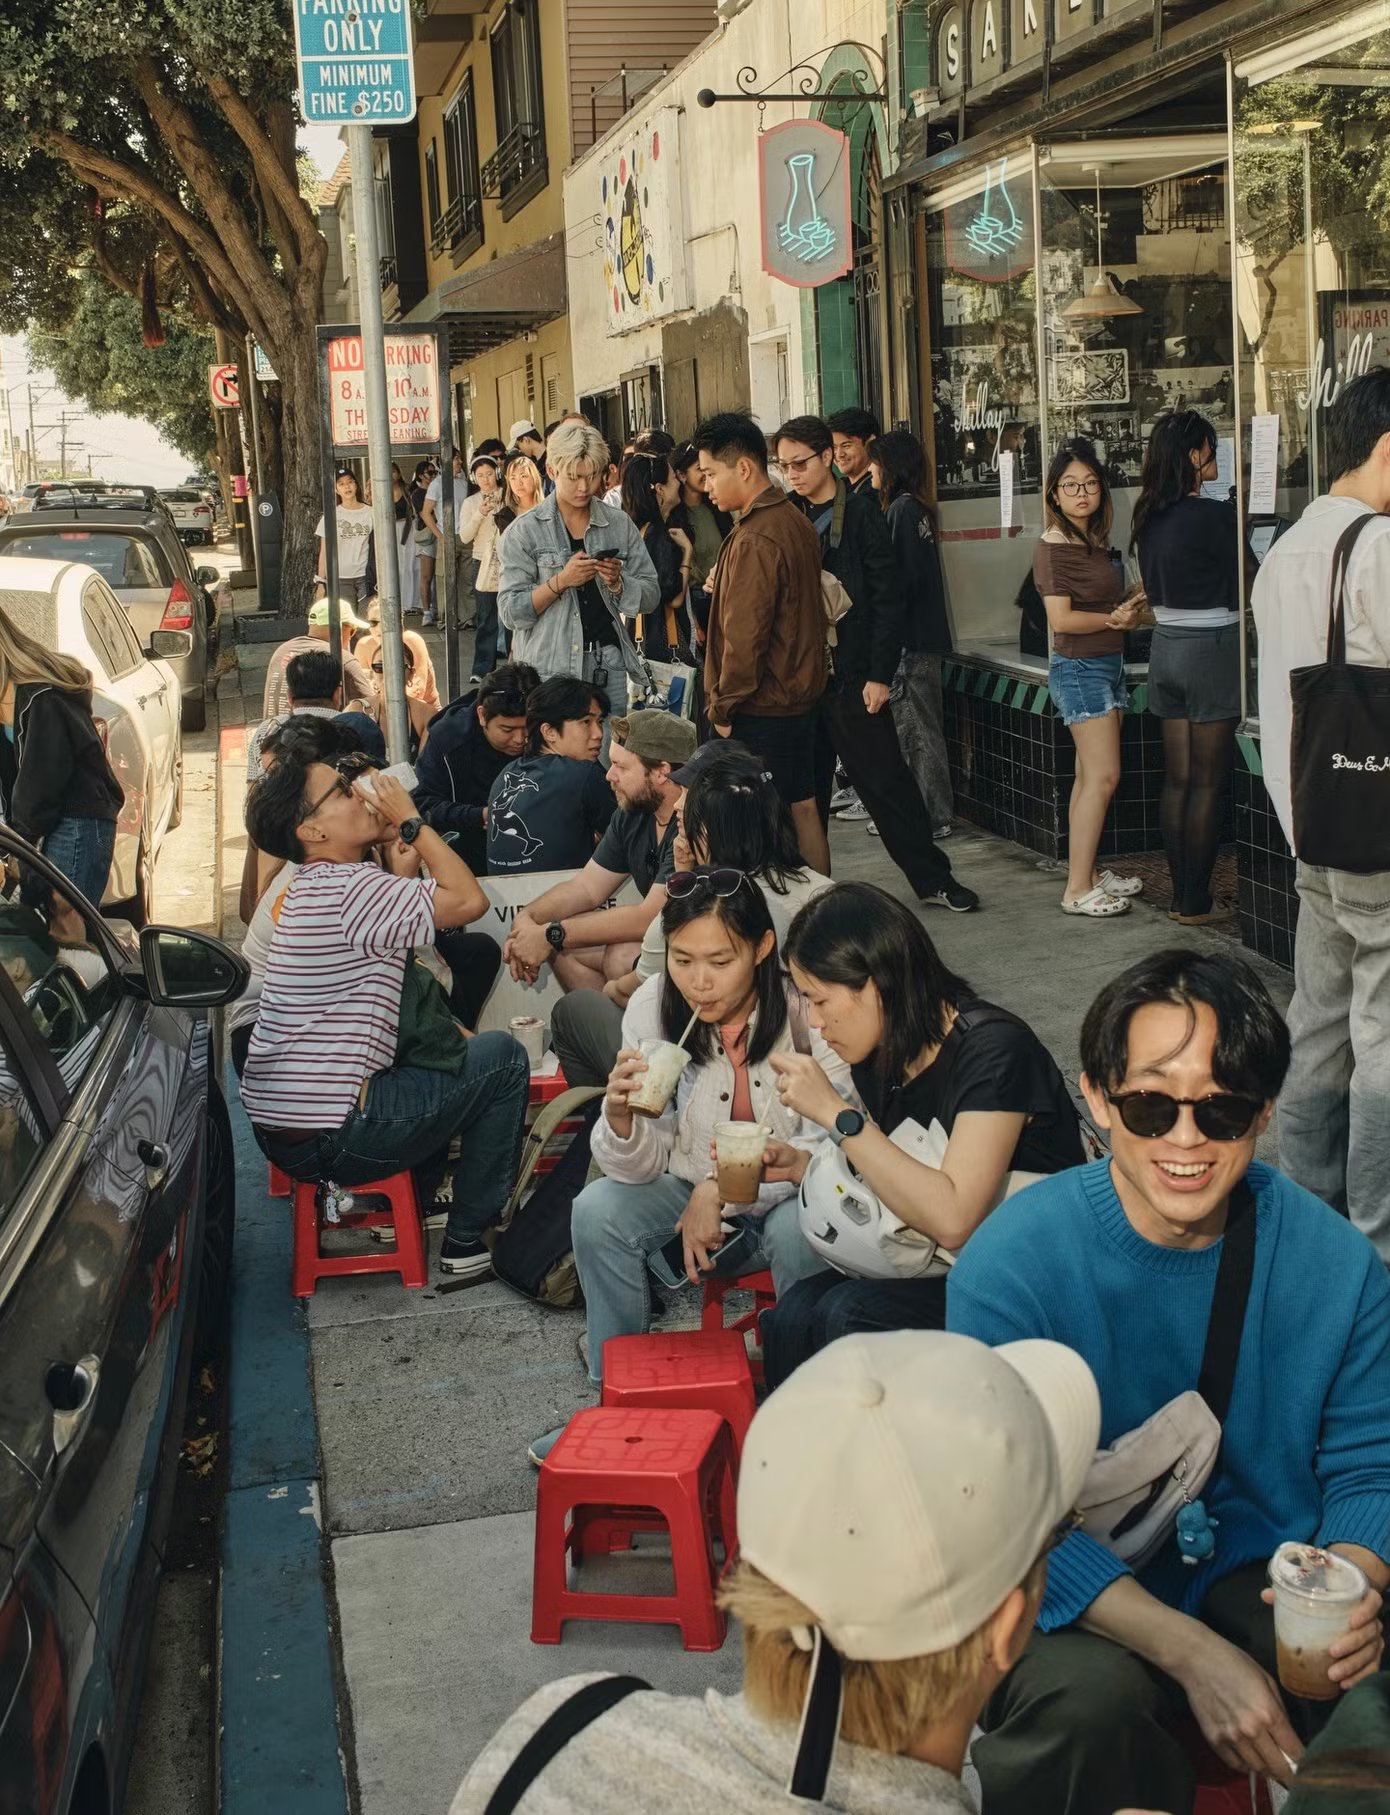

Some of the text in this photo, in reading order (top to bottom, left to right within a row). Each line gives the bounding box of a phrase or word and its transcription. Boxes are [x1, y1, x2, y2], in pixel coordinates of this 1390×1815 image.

[323, 19, 383, 52] ONLY
[947, 0, 1083, 77] SAK
[319, 63, 392, 87] MINIMUM
[311, 90, 404, 116] FINE $250
[332, 340, 432, 368] NO RKING
[341, 380, 352, 400] 8
[394, 377, 412, 398] 10
[412, 386, 433, 398] A.M.
[344, 406, 430, 426] THSDAY
[346, 427, 428, 441] STRE EANING
